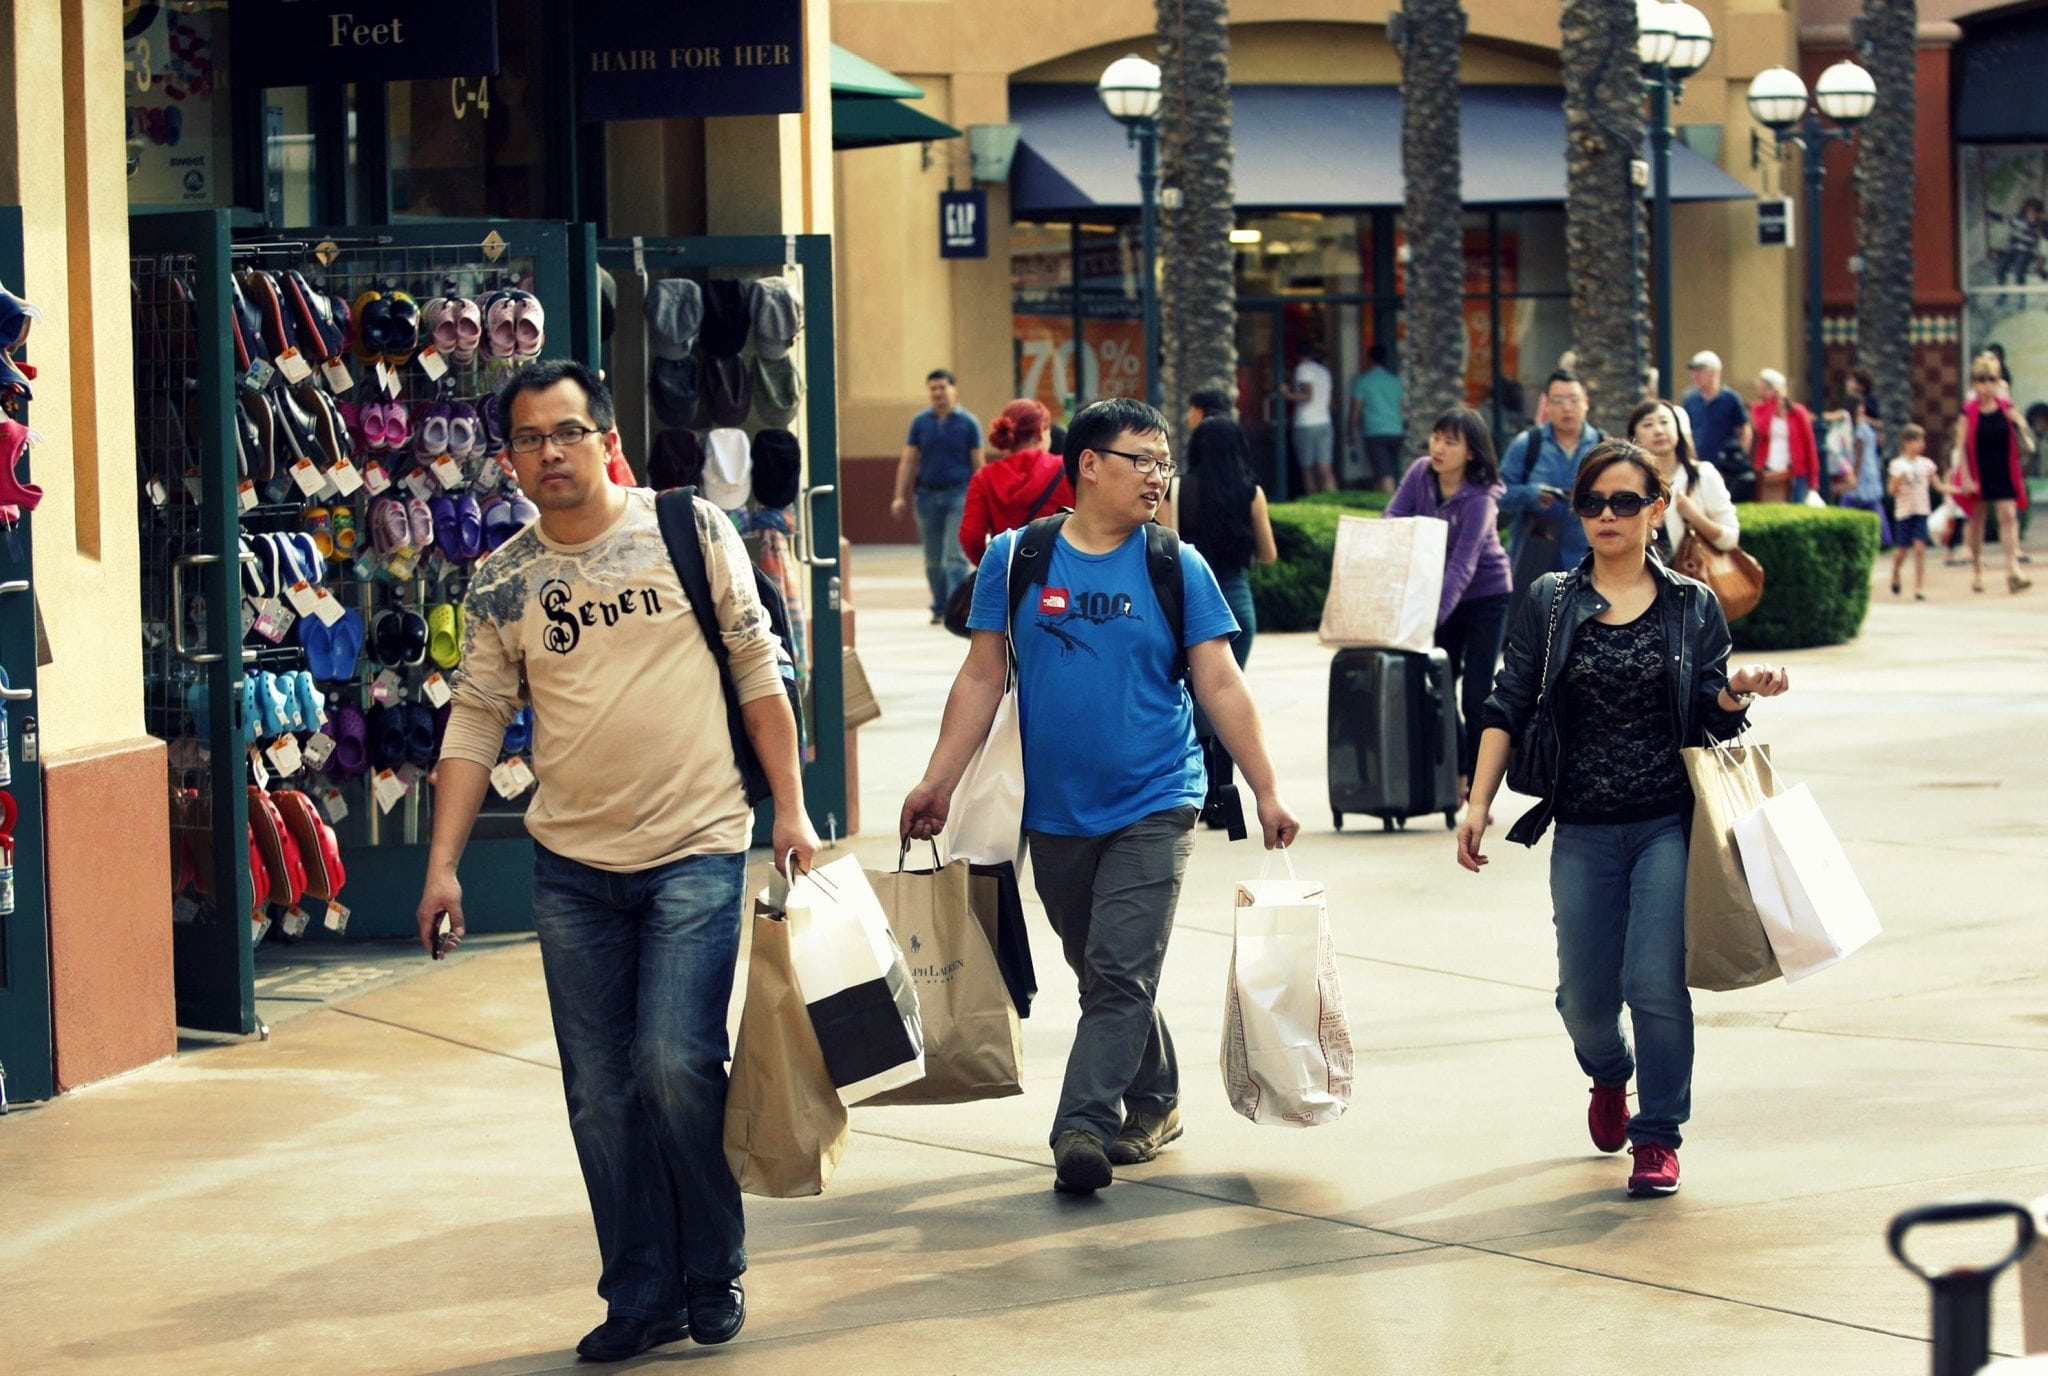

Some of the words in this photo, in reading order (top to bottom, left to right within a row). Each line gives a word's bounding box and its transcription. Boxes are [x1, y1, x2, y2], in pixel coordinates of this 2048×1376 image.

[328, 13, 405, 47] Feet
[591, 49, 657, 72] HAIR
[671, 47, 721, 69] FOR
[735, 44, 791, 66] HER
[452, 76, 490, 120] C-4
[169, 155, 205, 168] sweet
[539, 578, 663, 656] Seven
[1075, 591, 1132, 619] 100
